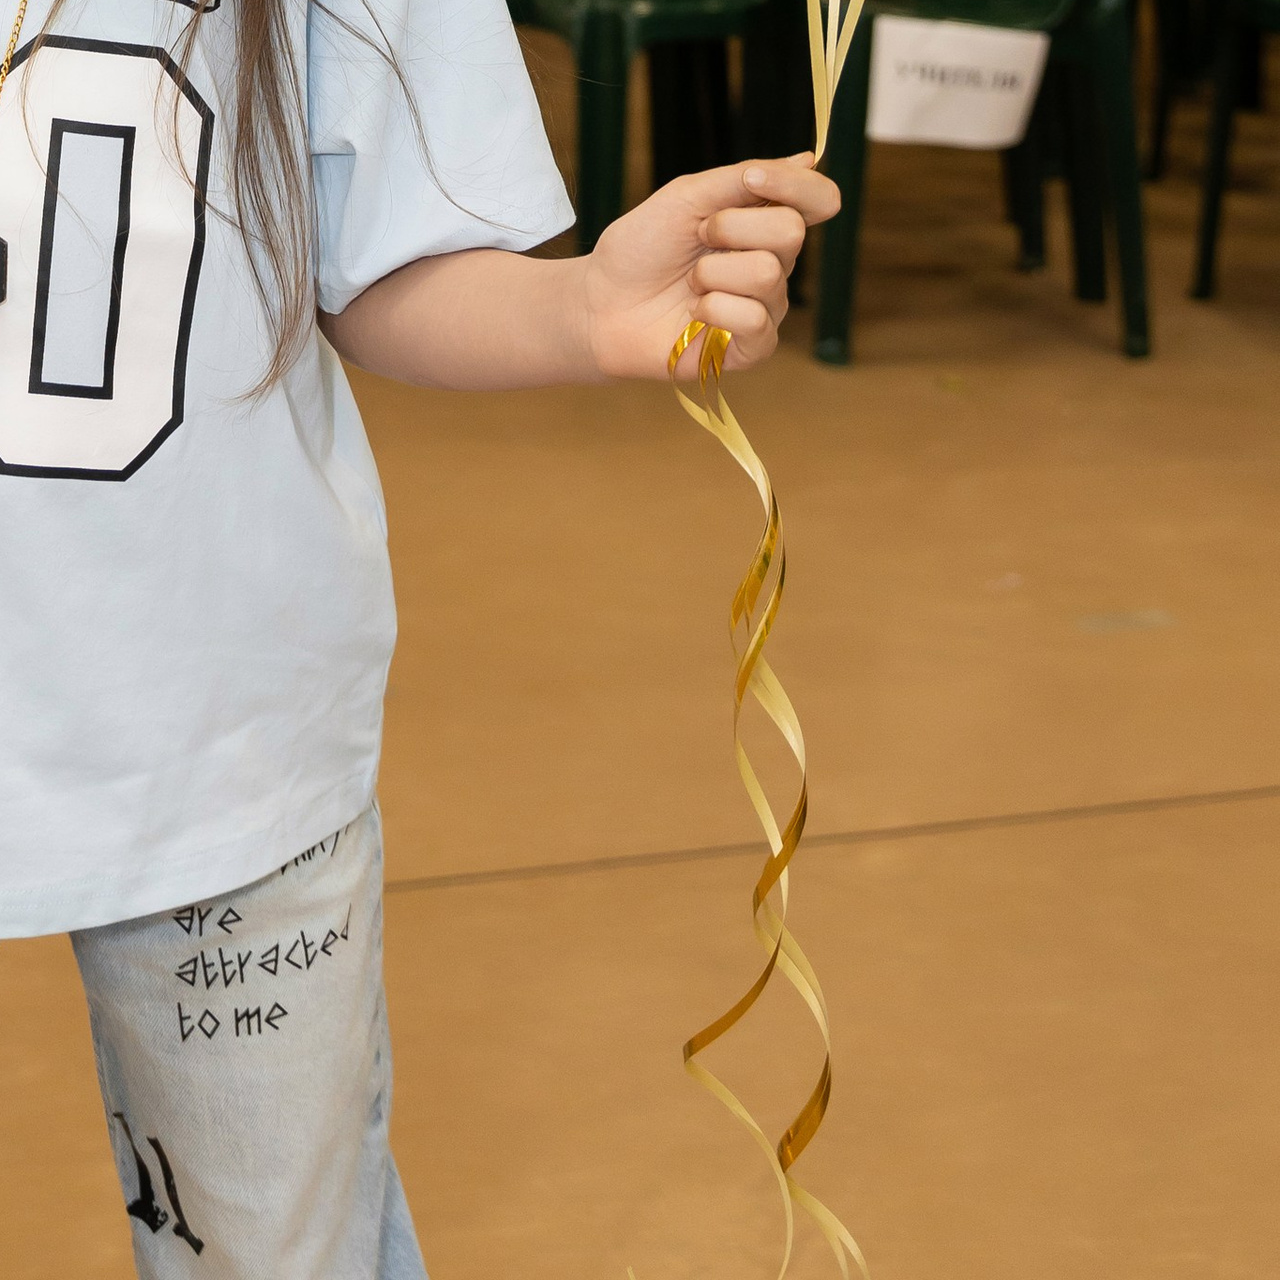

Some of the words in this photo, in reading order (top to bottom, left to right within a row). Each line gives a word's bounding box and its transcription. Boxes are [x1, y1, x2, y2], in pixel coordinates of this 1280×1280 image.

[172, 905, 243, 937] are
[174, 902, 352, 990] attracted
[177, 1001, 220, 1042] to
[233, 1001, 289, 1037] me
